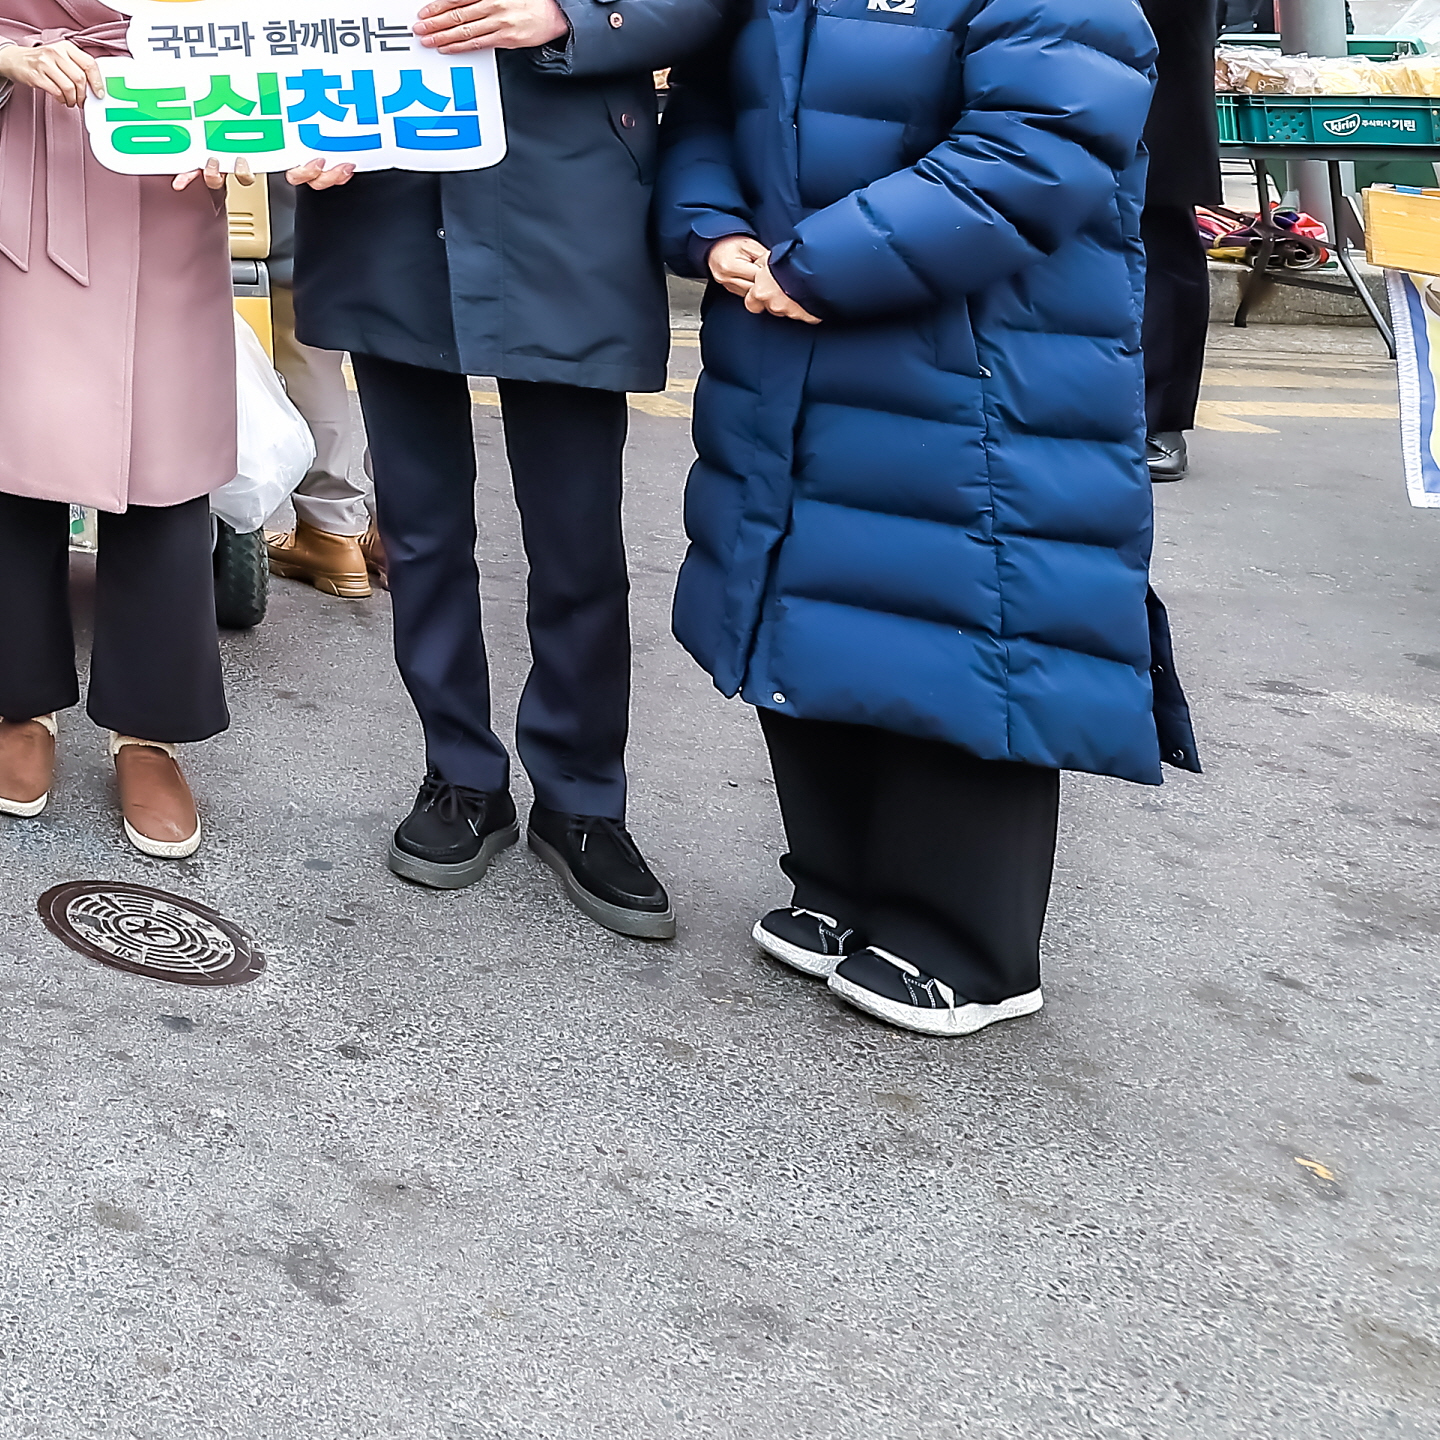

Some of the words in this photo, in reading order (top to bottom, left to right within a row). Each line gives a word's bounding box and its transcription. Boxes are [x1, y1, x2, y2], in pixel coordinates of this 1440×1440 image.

[147, 20, 256, 59] 국민과
[262, 16, 414, 56] 함께하는
[104, 66, 483, 155] 농심천심
[1391, 118, 1417, 132] 기린
